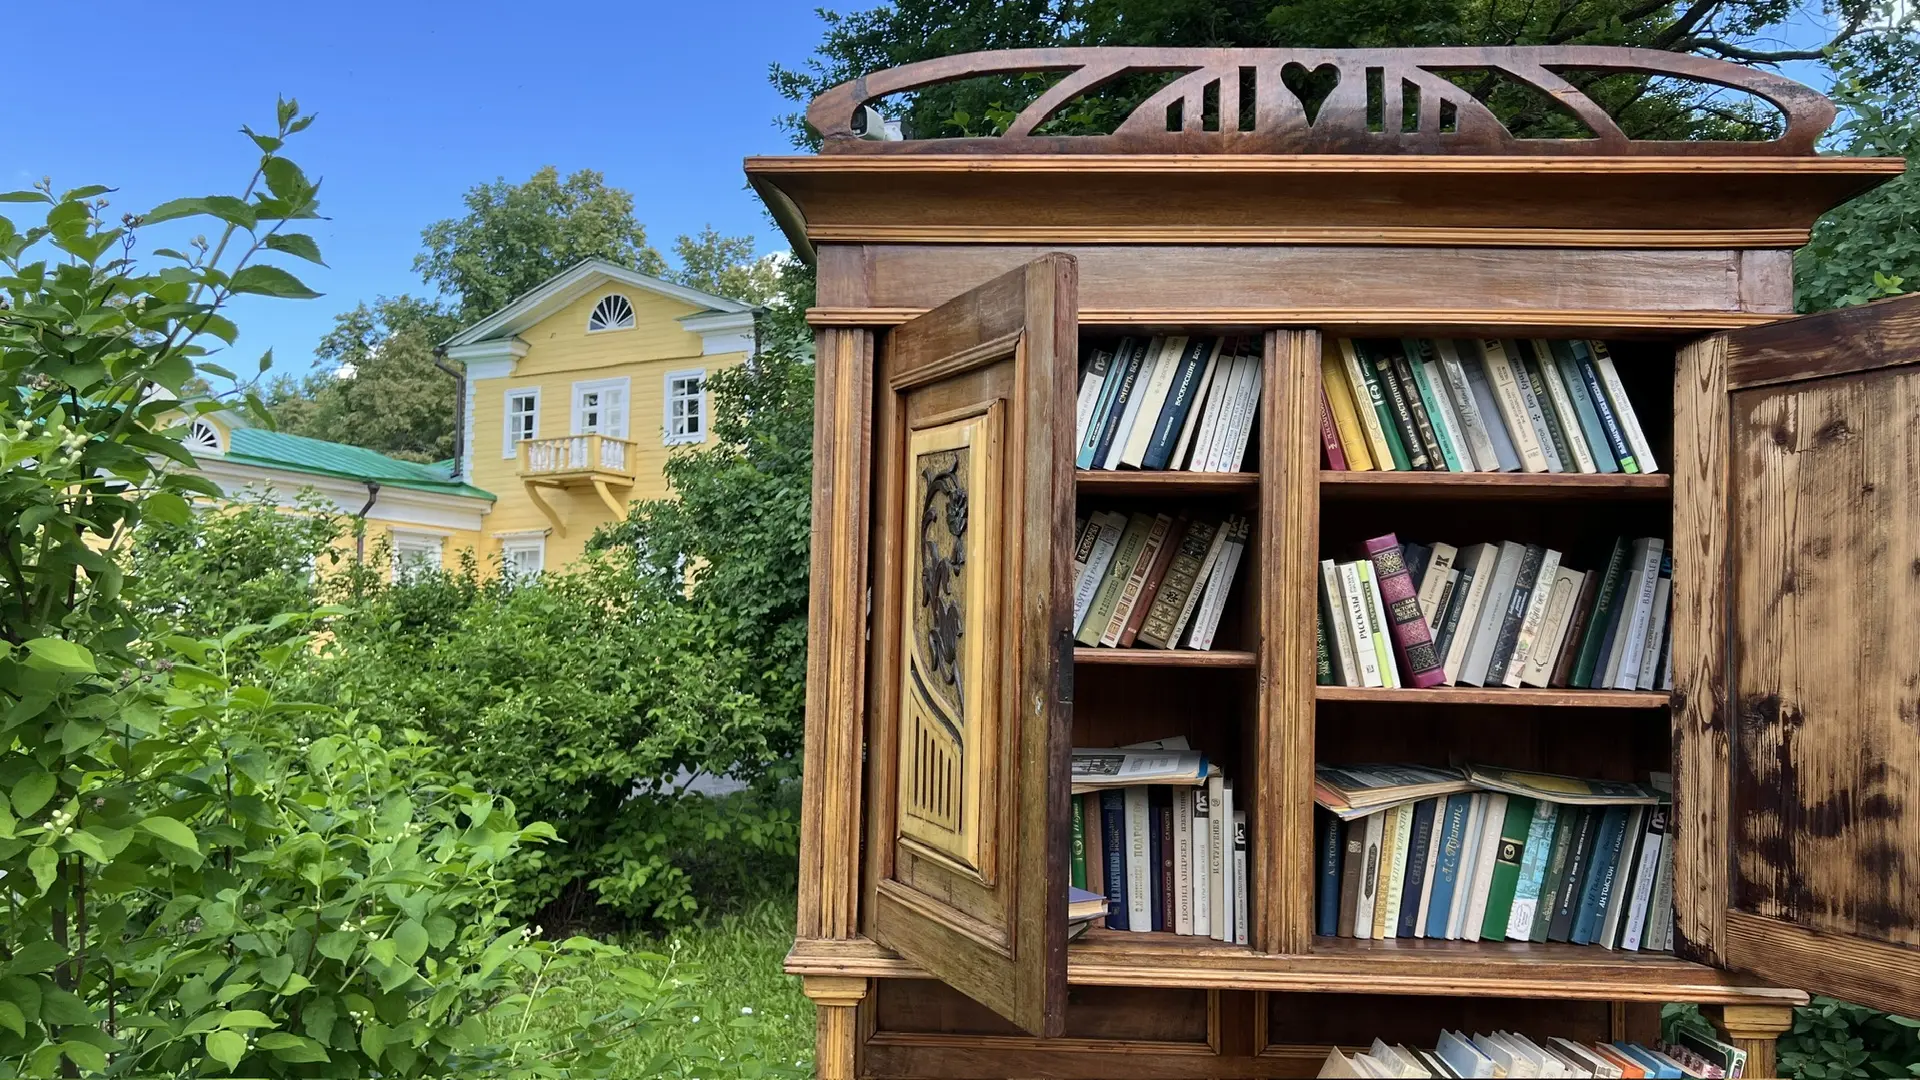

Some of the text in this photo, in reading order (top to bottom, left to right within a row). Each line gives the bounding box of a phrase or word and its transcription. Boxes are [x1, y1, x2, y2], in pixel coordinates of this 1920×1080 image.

[1119, 375, 1133, 403] СМЕРТЬ
[1388, 372, 1408, 420] РОСТОПЧИНА
[1352, 596, 1366, 639] РАССКАЗЫ
